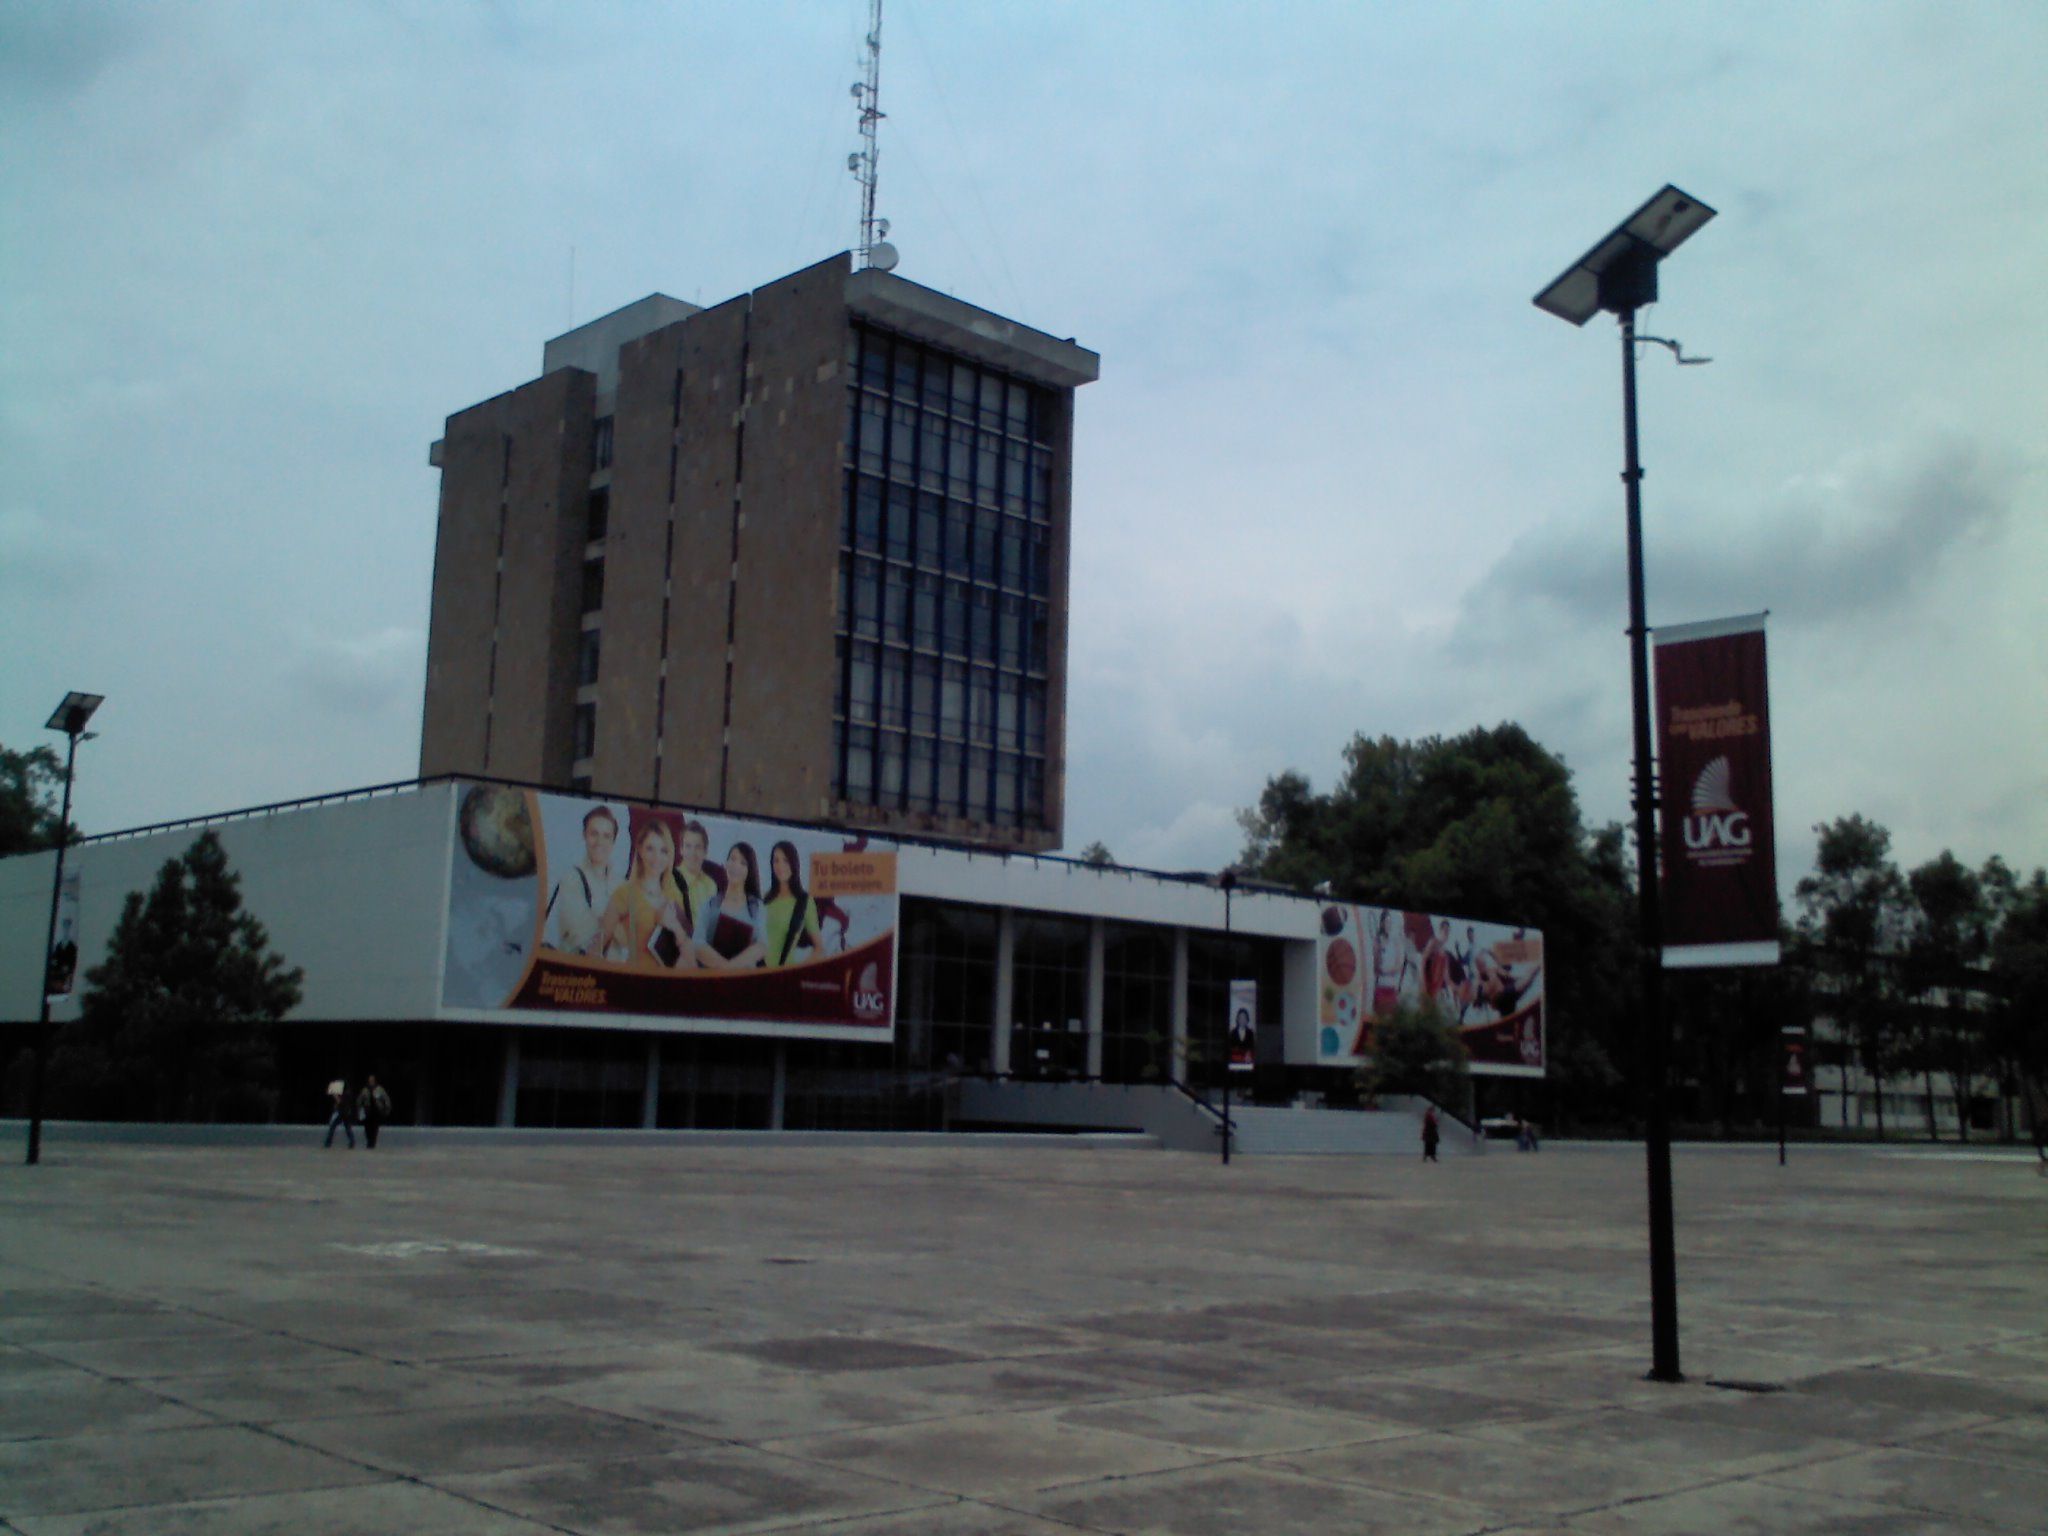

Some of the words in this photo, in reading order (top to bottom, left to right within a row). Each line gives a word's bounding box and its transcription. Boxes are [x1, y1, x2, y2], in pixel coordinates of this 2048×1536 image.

[1682, 812, 1751, 849] UAG
[813, 861, 829, 876] Tu
[831, 861, 875, 876] boleto
[554, 988, 608, 1004] VALORES
[853, 991, 884, 1011] UAG
